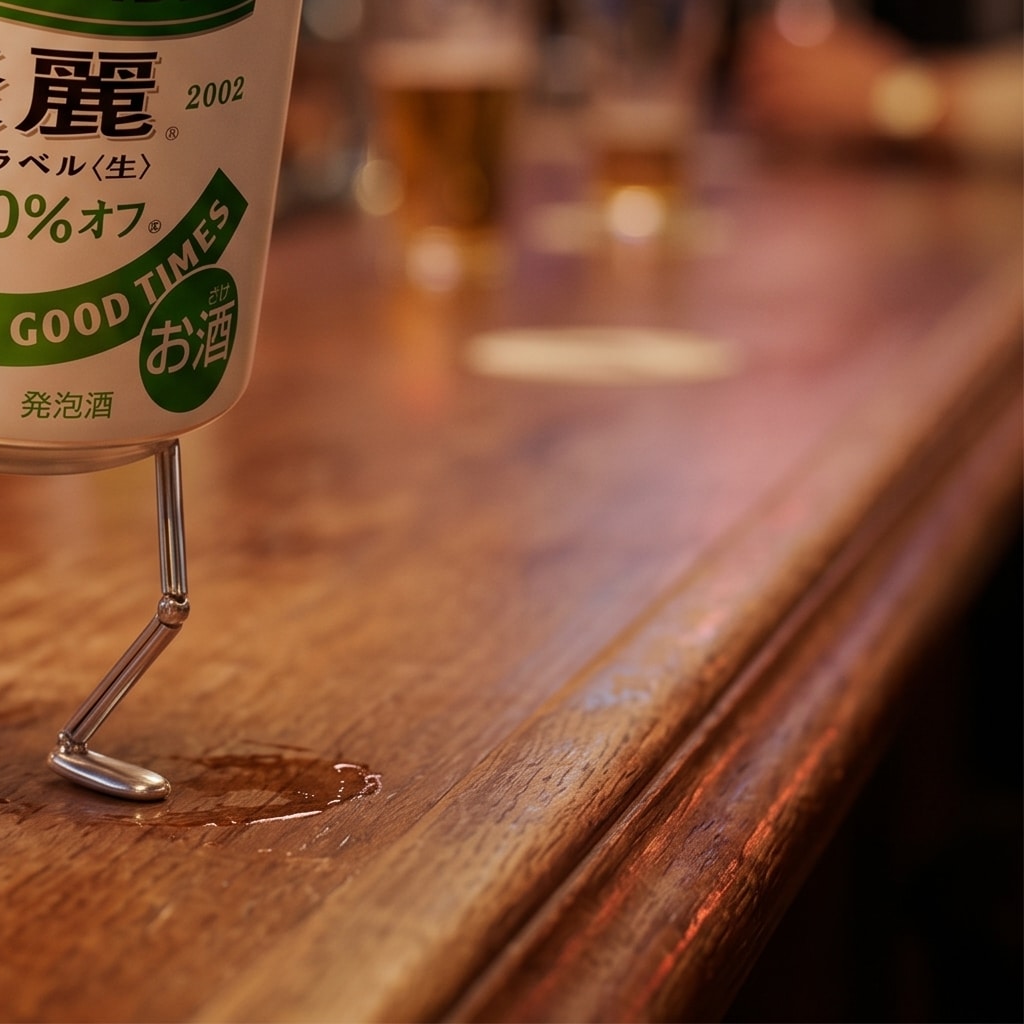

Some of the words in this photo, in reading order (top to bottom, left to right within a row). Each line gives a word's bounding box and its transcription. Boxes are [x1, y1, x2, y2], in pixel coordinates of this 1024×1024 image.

[185, 76, 244, 110] 2002
[10, 292, 131, 346] GOOD
[134, 199, 230, 306] TIMES
[146, 299, 236, 375] お酒
[21, 391, 114, 419] 発泡酒
